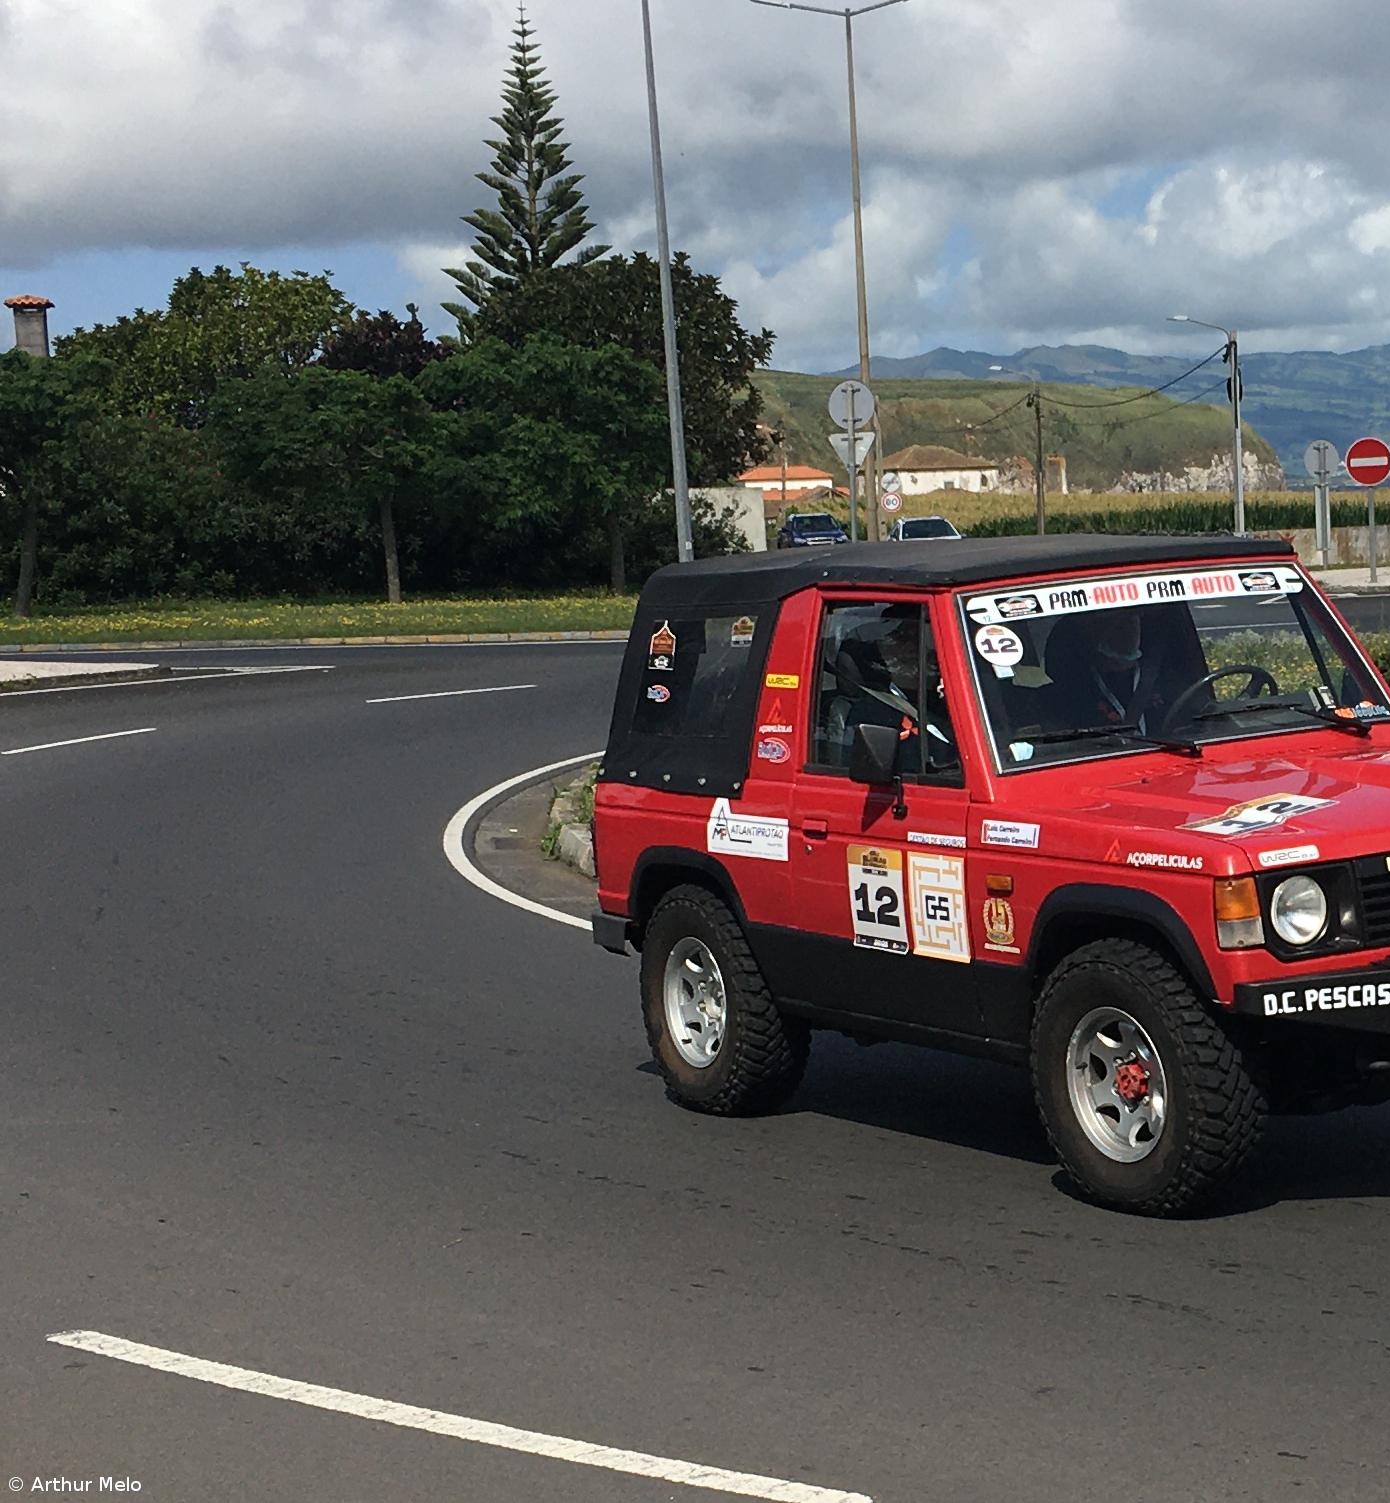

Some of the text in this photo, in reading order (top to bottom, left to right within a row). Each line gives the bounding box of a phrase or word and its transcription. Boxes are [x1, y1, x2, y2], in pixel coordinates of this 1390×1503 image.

[1093, 582, 1140, 604] AUTO
[1191, 574, 1236, 595] AUTO
[980, 637, 1019, 654] 12
[1220, 801, 1308, 828] 12
[854, 882, 901, 928] 12
